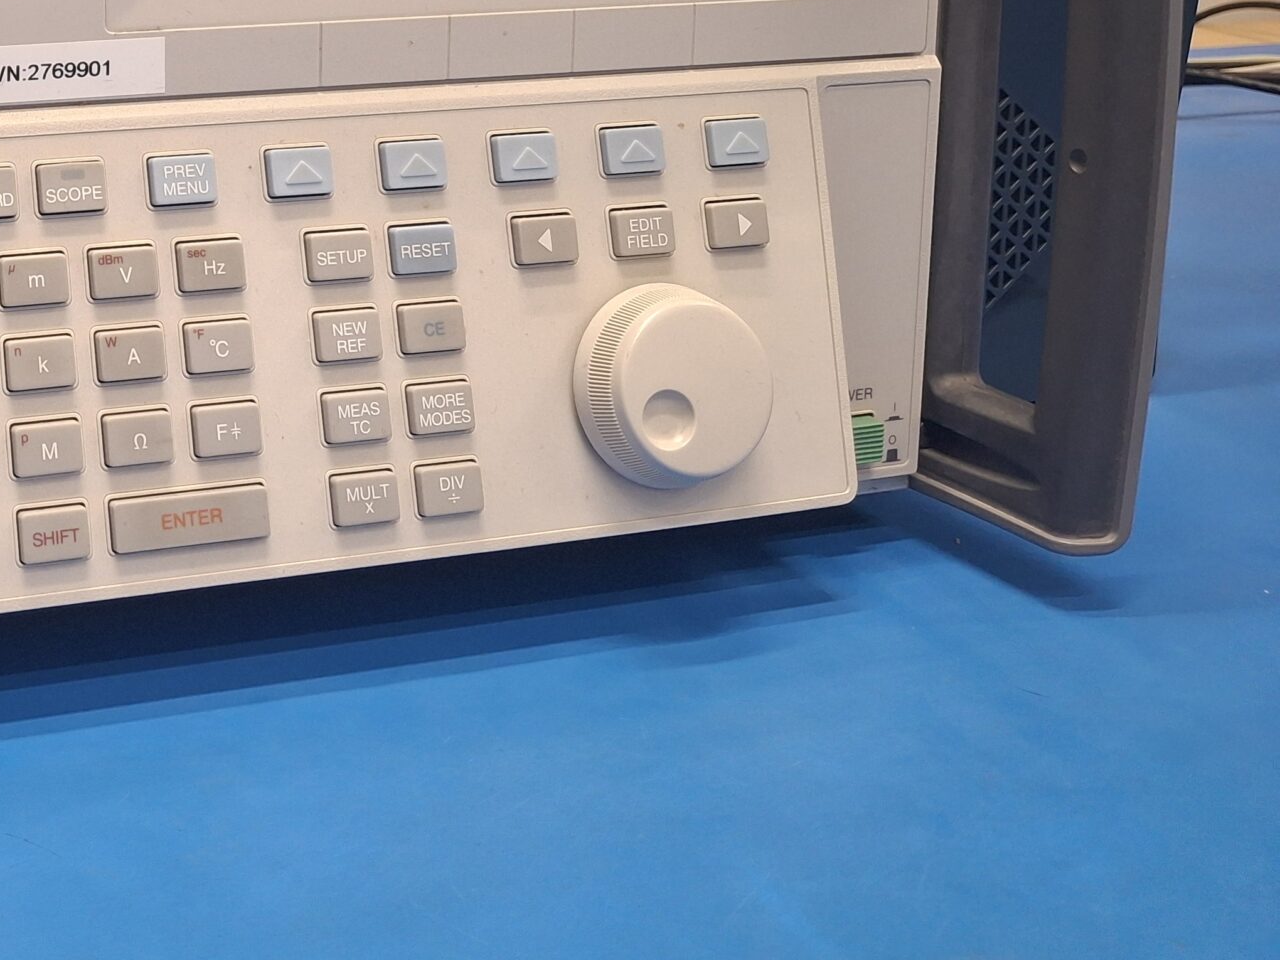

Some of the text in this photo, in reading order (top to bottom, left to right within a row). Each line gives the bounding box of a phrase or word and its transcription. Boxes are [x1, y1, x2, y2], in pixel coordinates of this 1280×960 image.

[163, 162, 206, 178] PREV
[45, 185, 103, 204] SCOPE
[163, 179, 210, 197] MENU
[629, 217, 662, 232] EDIT
[627, 233, 669, 249] FIELD
[187, 248, 207, 259] sec
[317, 249, 367, 266] SETUP
[401, 242, 451, 259] RESET
[97, 253, 124, 266] dBm
[204, 260, 227, 276] Hz
[332, 321, 367, 337] NEW
[423, 321, 447, 337] CE
[209, 339, 231, 358] °C
[336, 338, 367, 354] REF
[421, 392, 465, 410] MORE
[337, 401, 381, 419] MEAS
[350, 419, 371, 435] TC
[419, 410, 472, 428] MODES
[439, 475, 466, 491] DIV
[346, 483, 390, 503] MULT
[161, 507, 223, 530] ENTER
[32, 528, 80, 548] SHIFT
